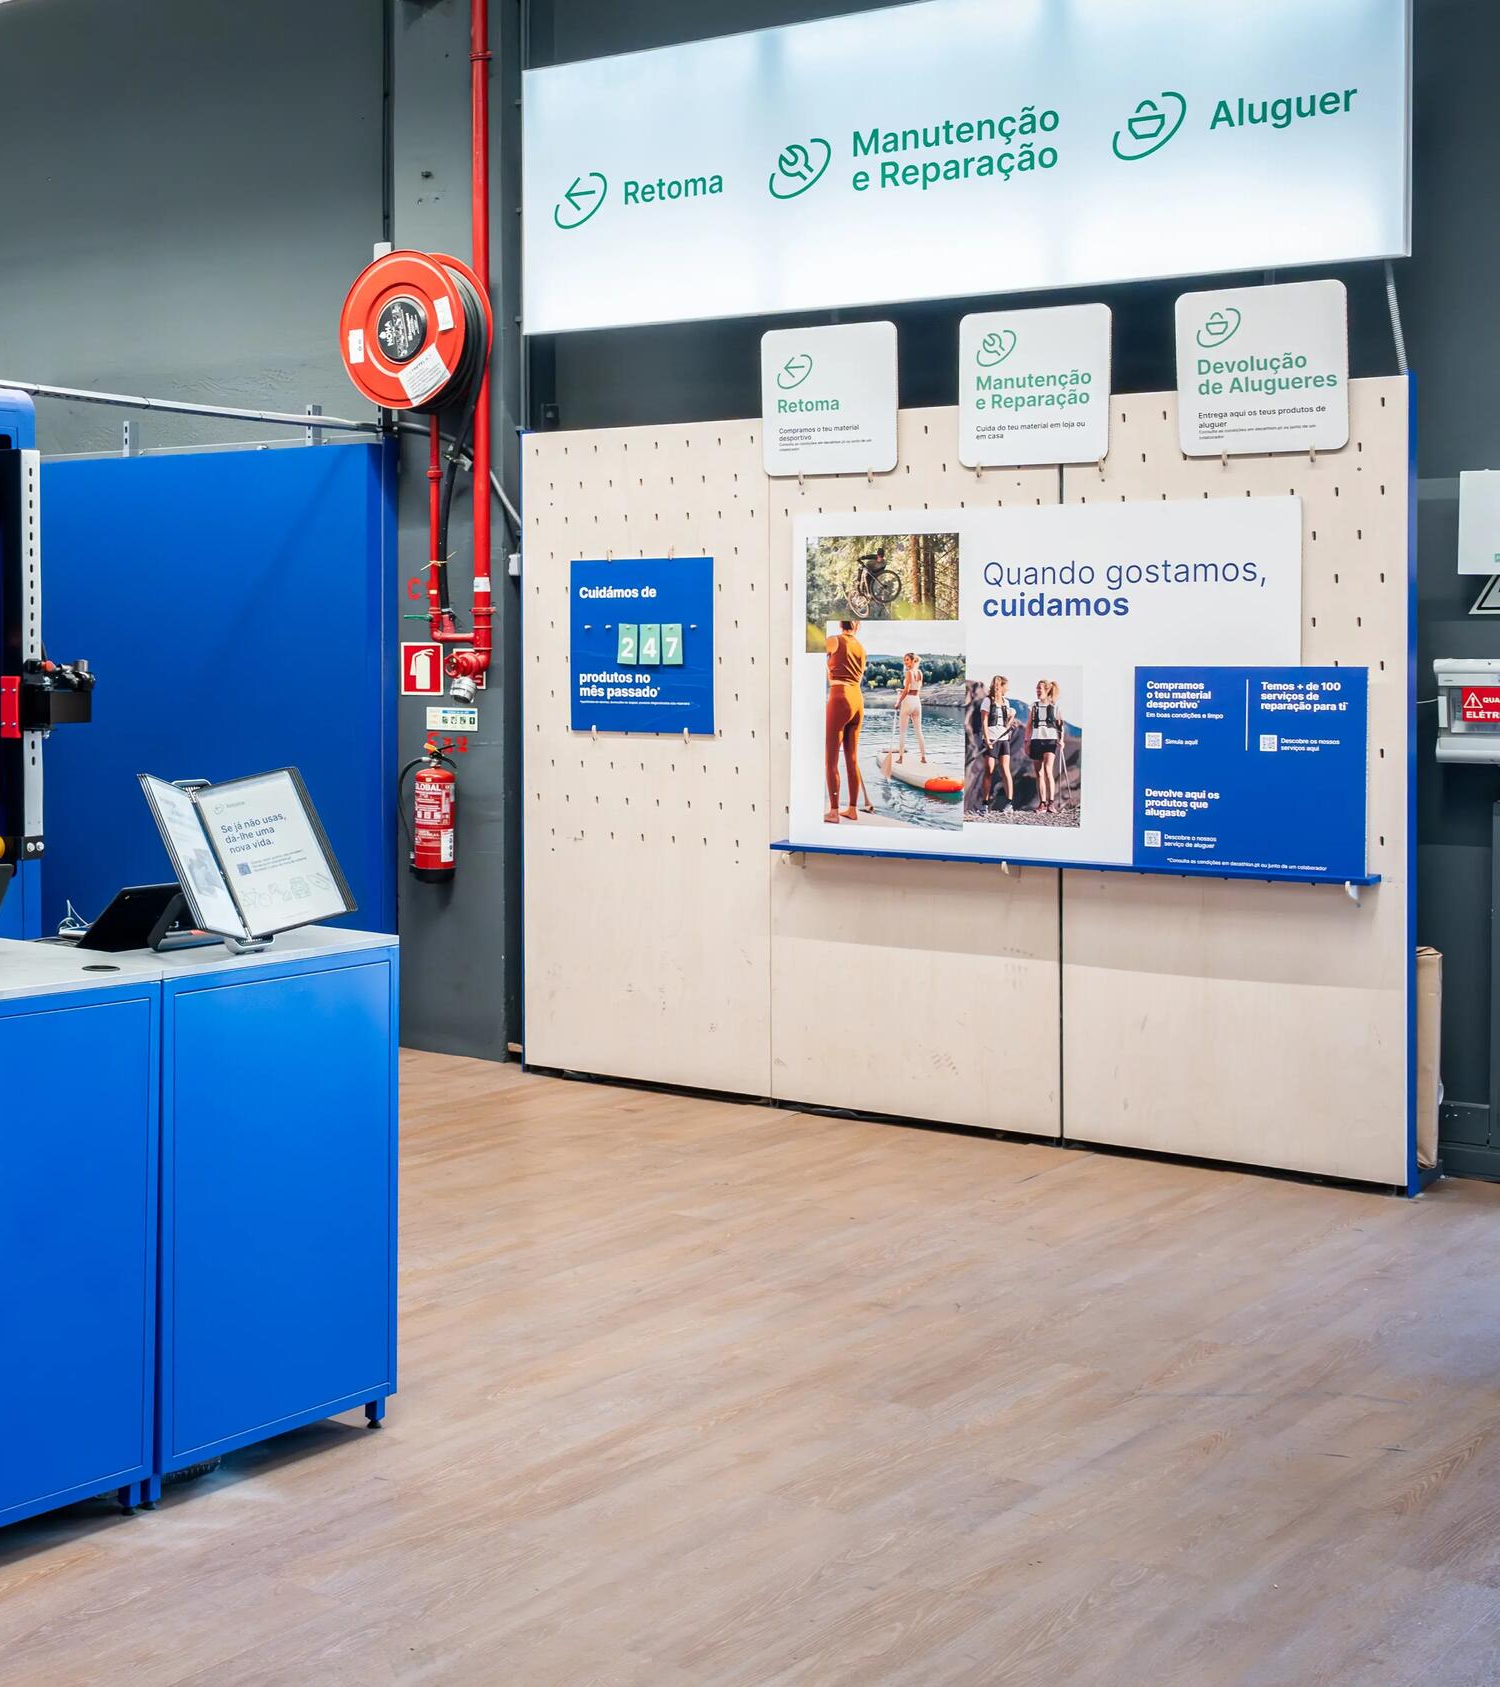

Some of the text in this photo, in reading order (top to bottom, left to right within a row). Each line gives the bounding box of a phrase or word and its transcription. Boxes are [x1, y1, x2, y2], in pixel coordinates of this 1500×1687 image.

[1210, 89, 1358, 133] Aluguer
[852, 105, 1060, 158] Manutenção
[852, 141, 1058, 194] e Reparação
[623, 172, 724, 205] Retoma
[1198, 352, 1306, 375] Devolução
[976, 370, 1091, 391] Manutenção
[1198, 375, 1337, 395] de Alugueres
[778, 399, 839, 413] Retoma
[976, 389, 1089, 411] e Reparação
[1198, 412, 1227, 420] Entrega
[1230, 410, 1245, 418] aqui
[1278, 407, 1314, 416] produtos
[1020, 422, 1048, 430] material
[983, 556, 1266, 591] Quando gostamos,
[579, 586, 656, 598] Cuidámos de
[982, 593, 1130, 617] cuidamos
[580, 672, 650, 685] produtos no
[580, 685, 604, 696] mês
[1146, 681, 1204, 691] Compramos
[1261, 681, 1294, 691] Temos
[1306, 682, 1319, 691] de
[1322, 682, 1341, 691] 100
[1146, 691, 1211, 700] o teu material
[1261, 692, 1319, 702] serviços de
[1261, 701, 1311, 711] reparação
[1313, 703, 1337, 712] para
[1145, 788, 1220, 800] Devolve aqui os
[1145, 798, 1208, 809] produtos que
[221, 813, 286, 834] Se já não usas,
[225, 827, 274, 844] dá-lhe uma
[230, 839, 274, 854] nova vida.
